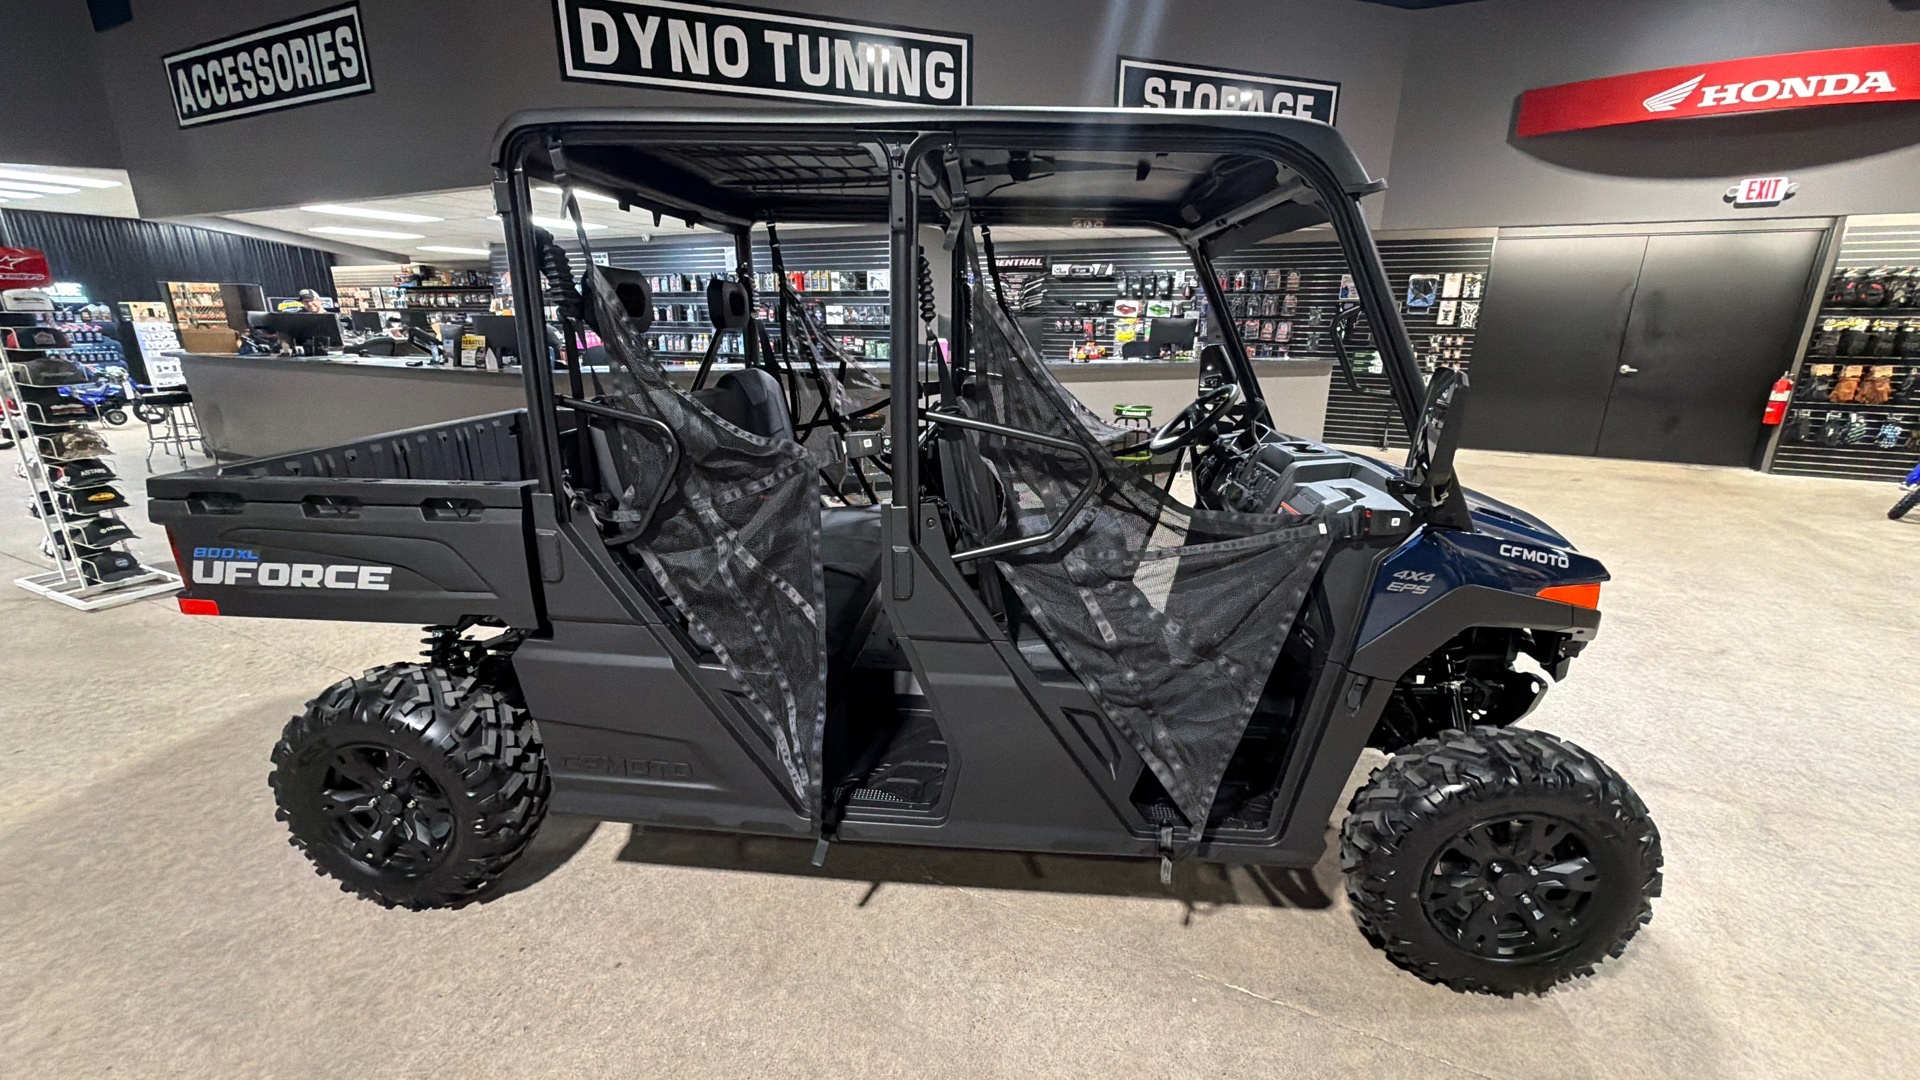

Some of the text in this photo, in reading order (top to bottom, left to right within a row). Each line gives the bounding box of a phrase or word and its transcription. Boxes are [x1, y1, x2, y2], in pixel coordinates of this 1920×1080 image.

[578, 7, 954, 99] DYNO TUNING
[176, 25, 359, 114] ACCESSORIES
[1697, 71, 1896, 108] HONDA
[1745, 179, 1782, 200] EXIT
[1499, 544, 1570, 569] CFMOTO
[192, 560, 393, 591] UFORCE
[1392, 570, 1436, 583] 4X4
[1386, 582, 1432, 595] EPS
[564, 754, 693, 778] CFMOTO
